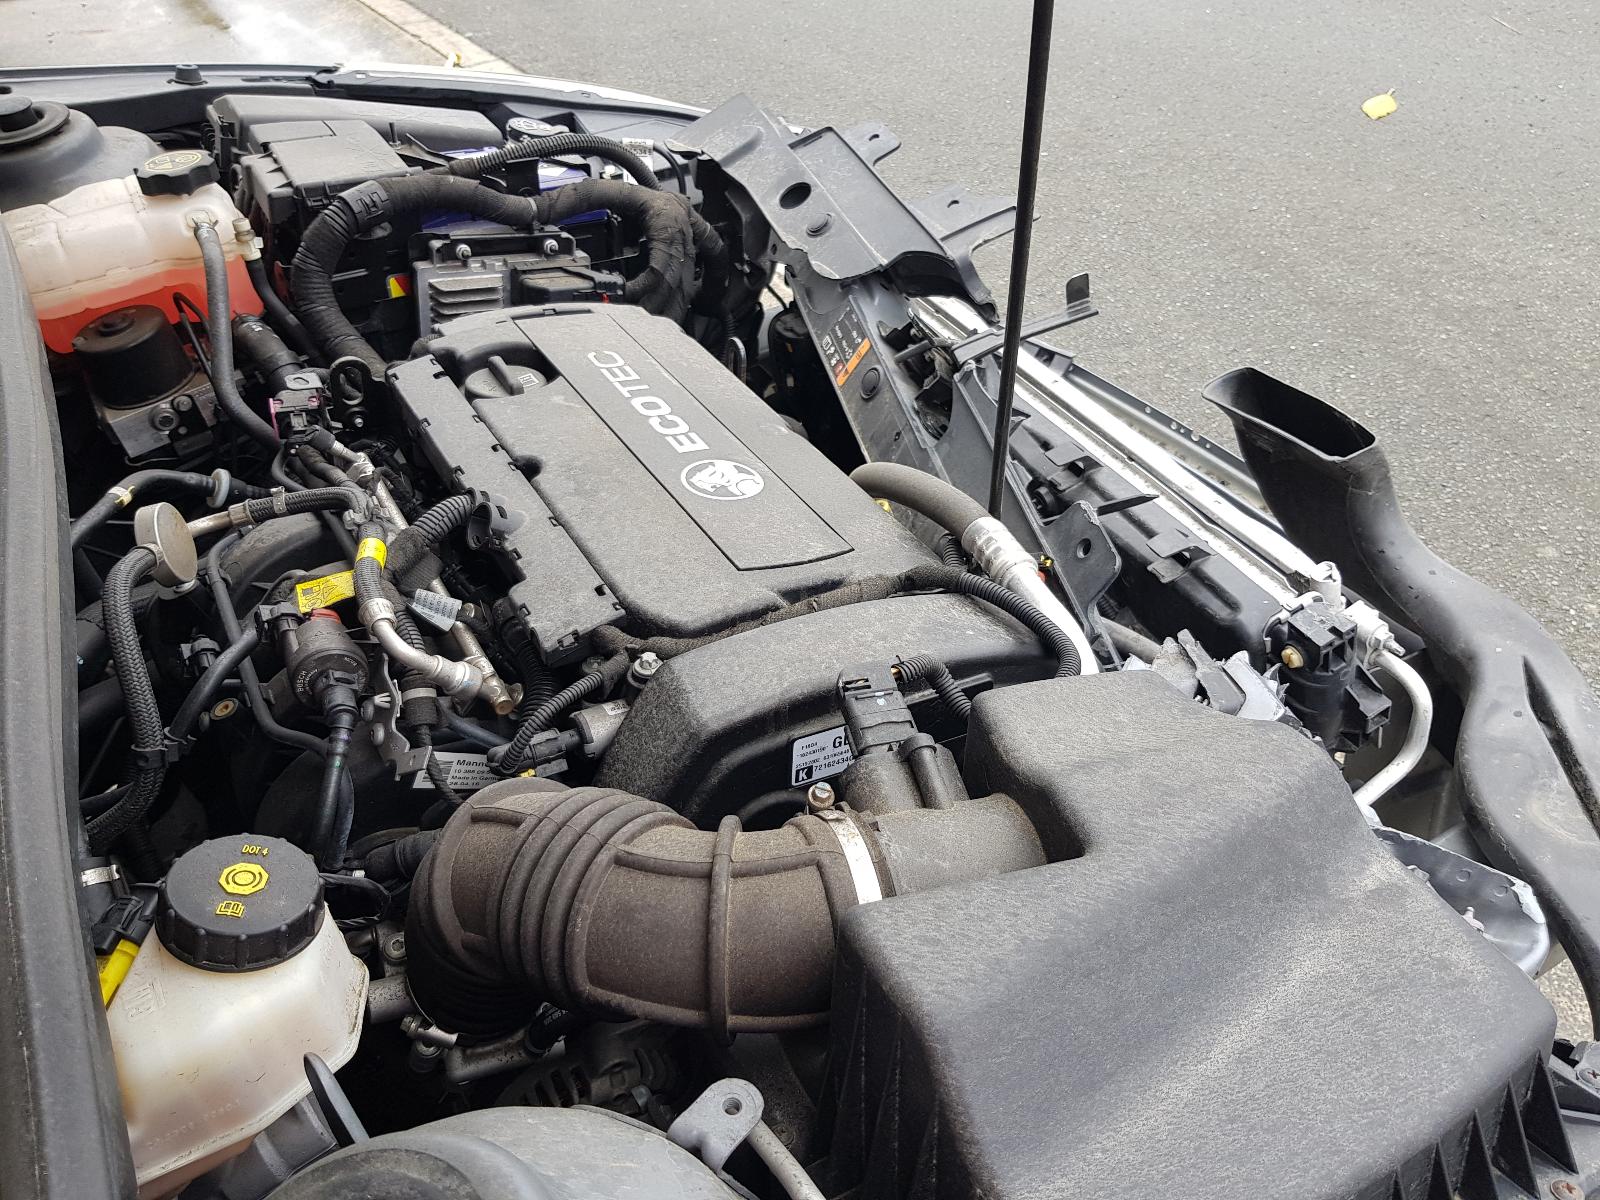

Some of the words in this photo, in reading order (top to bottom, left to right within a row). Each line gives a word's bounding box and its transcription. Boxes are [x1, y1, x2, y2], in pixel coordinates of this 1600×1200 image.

[587, 350, 710, 454] ECOTEC
[296, 670, 307, 693] BOSCH
[241, 844, 261, 855] DOT
[261, 847, 270, 857] 4
